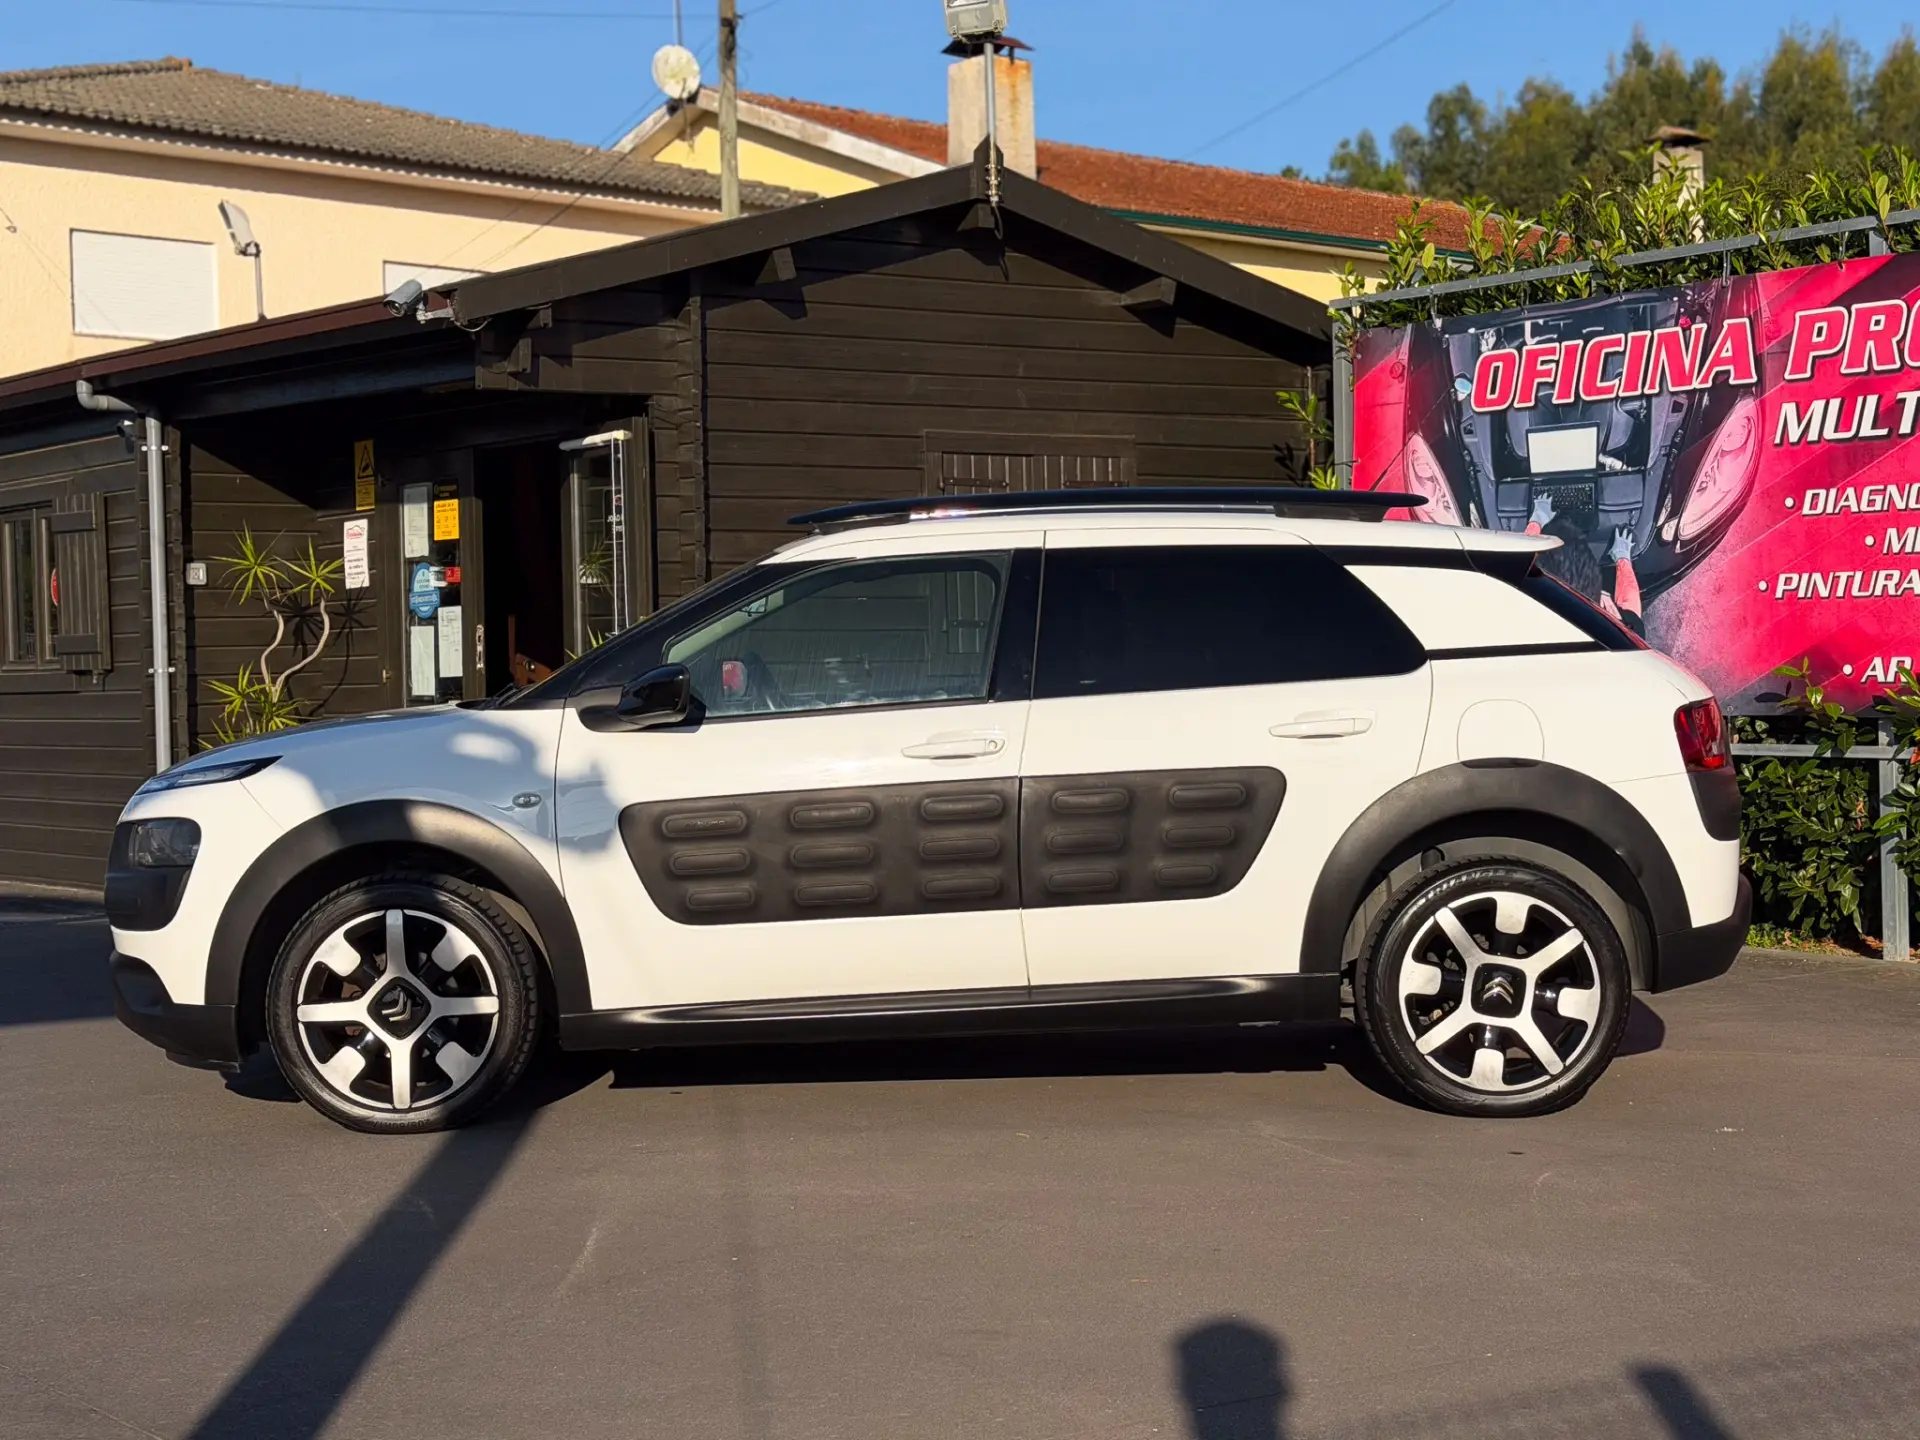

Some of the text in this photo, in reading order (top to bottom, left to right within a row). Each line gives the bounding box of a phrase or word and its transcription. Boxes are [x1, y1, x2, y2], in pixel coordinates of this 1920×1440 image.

[1471, 318, 1757, 412] OFICINA
[1775, 568, 1920, 599] PINTURA
[1860, 656, 1912, 683] AR
